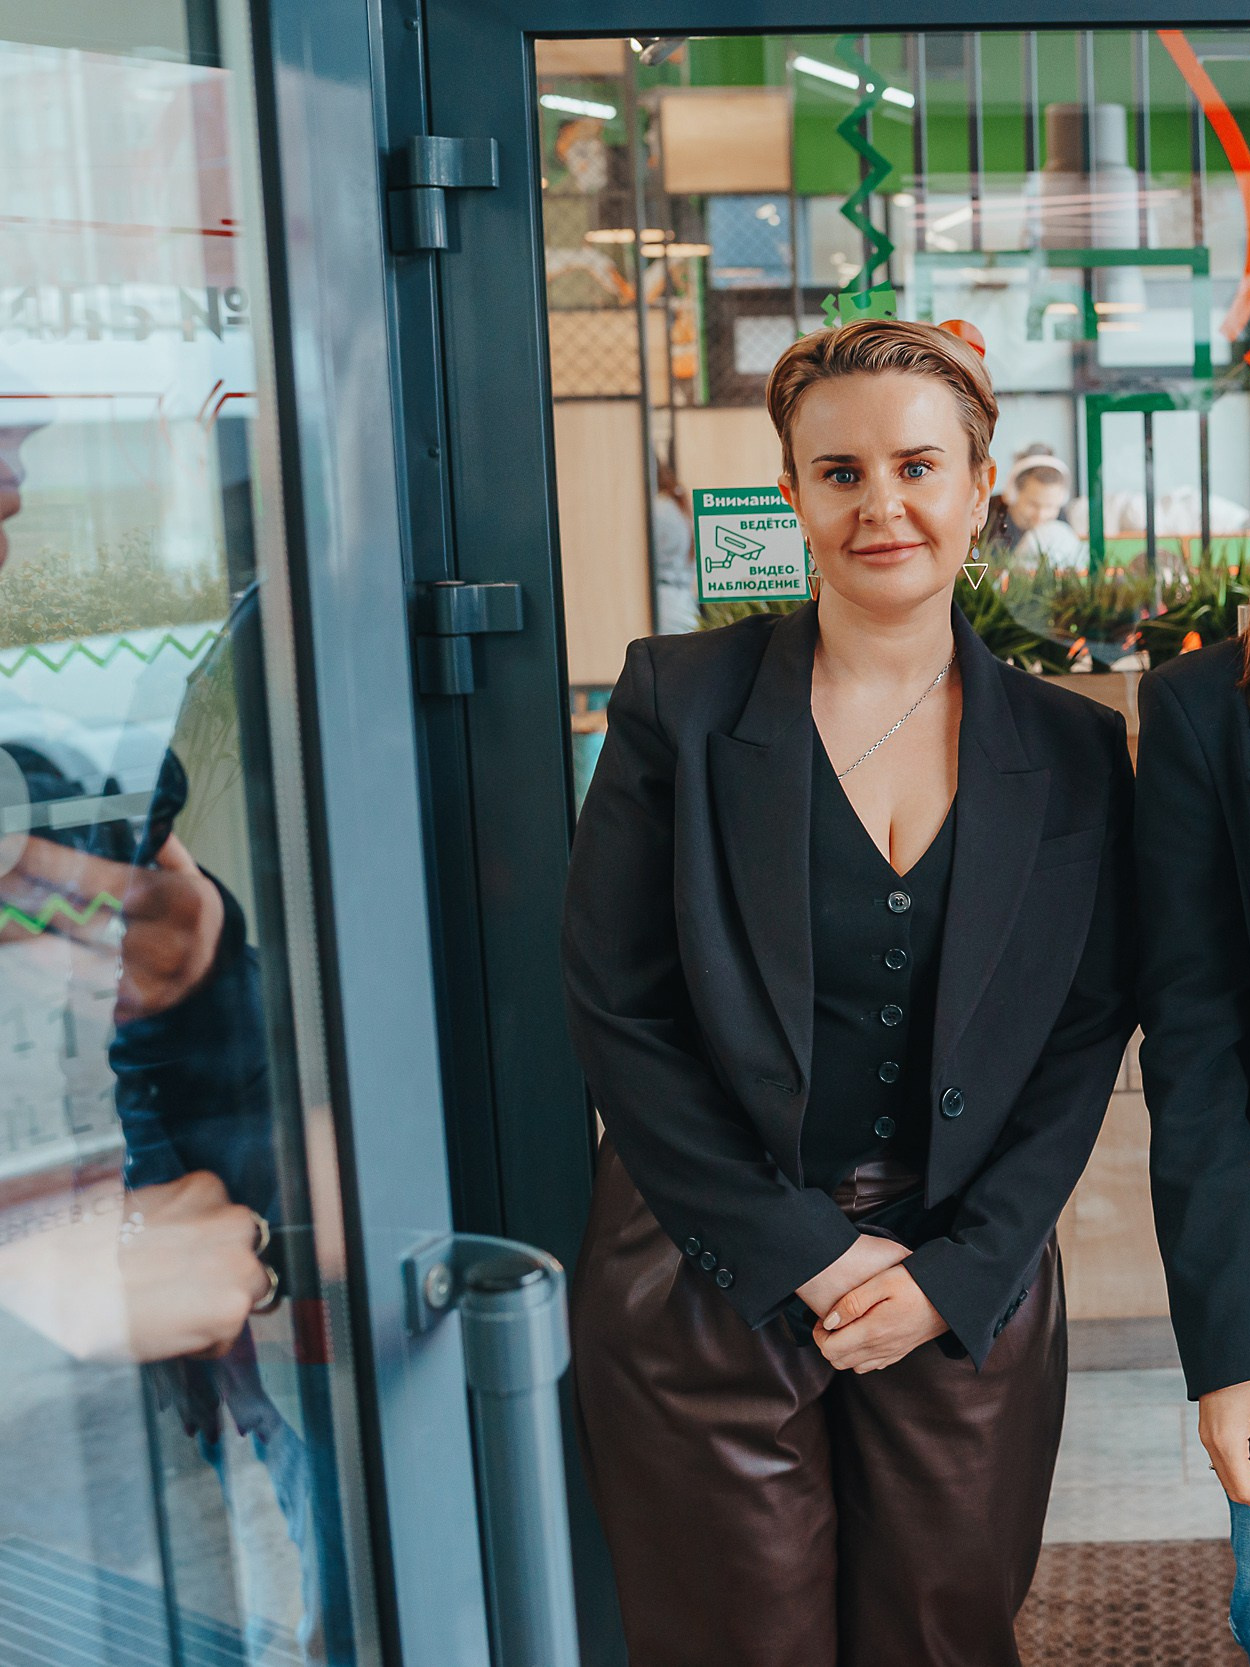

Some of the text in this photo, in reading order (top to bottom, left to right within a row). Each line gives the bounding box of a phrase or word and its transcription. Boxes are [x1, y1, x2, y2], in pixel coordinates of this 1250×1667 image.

[740, 518, 797, 531] ВЕДЁТСЯ
[749, 565, 799, 576] ВИДЕО-
[708, 579, 800, 591] НАБЛЮДЕНИЕ
